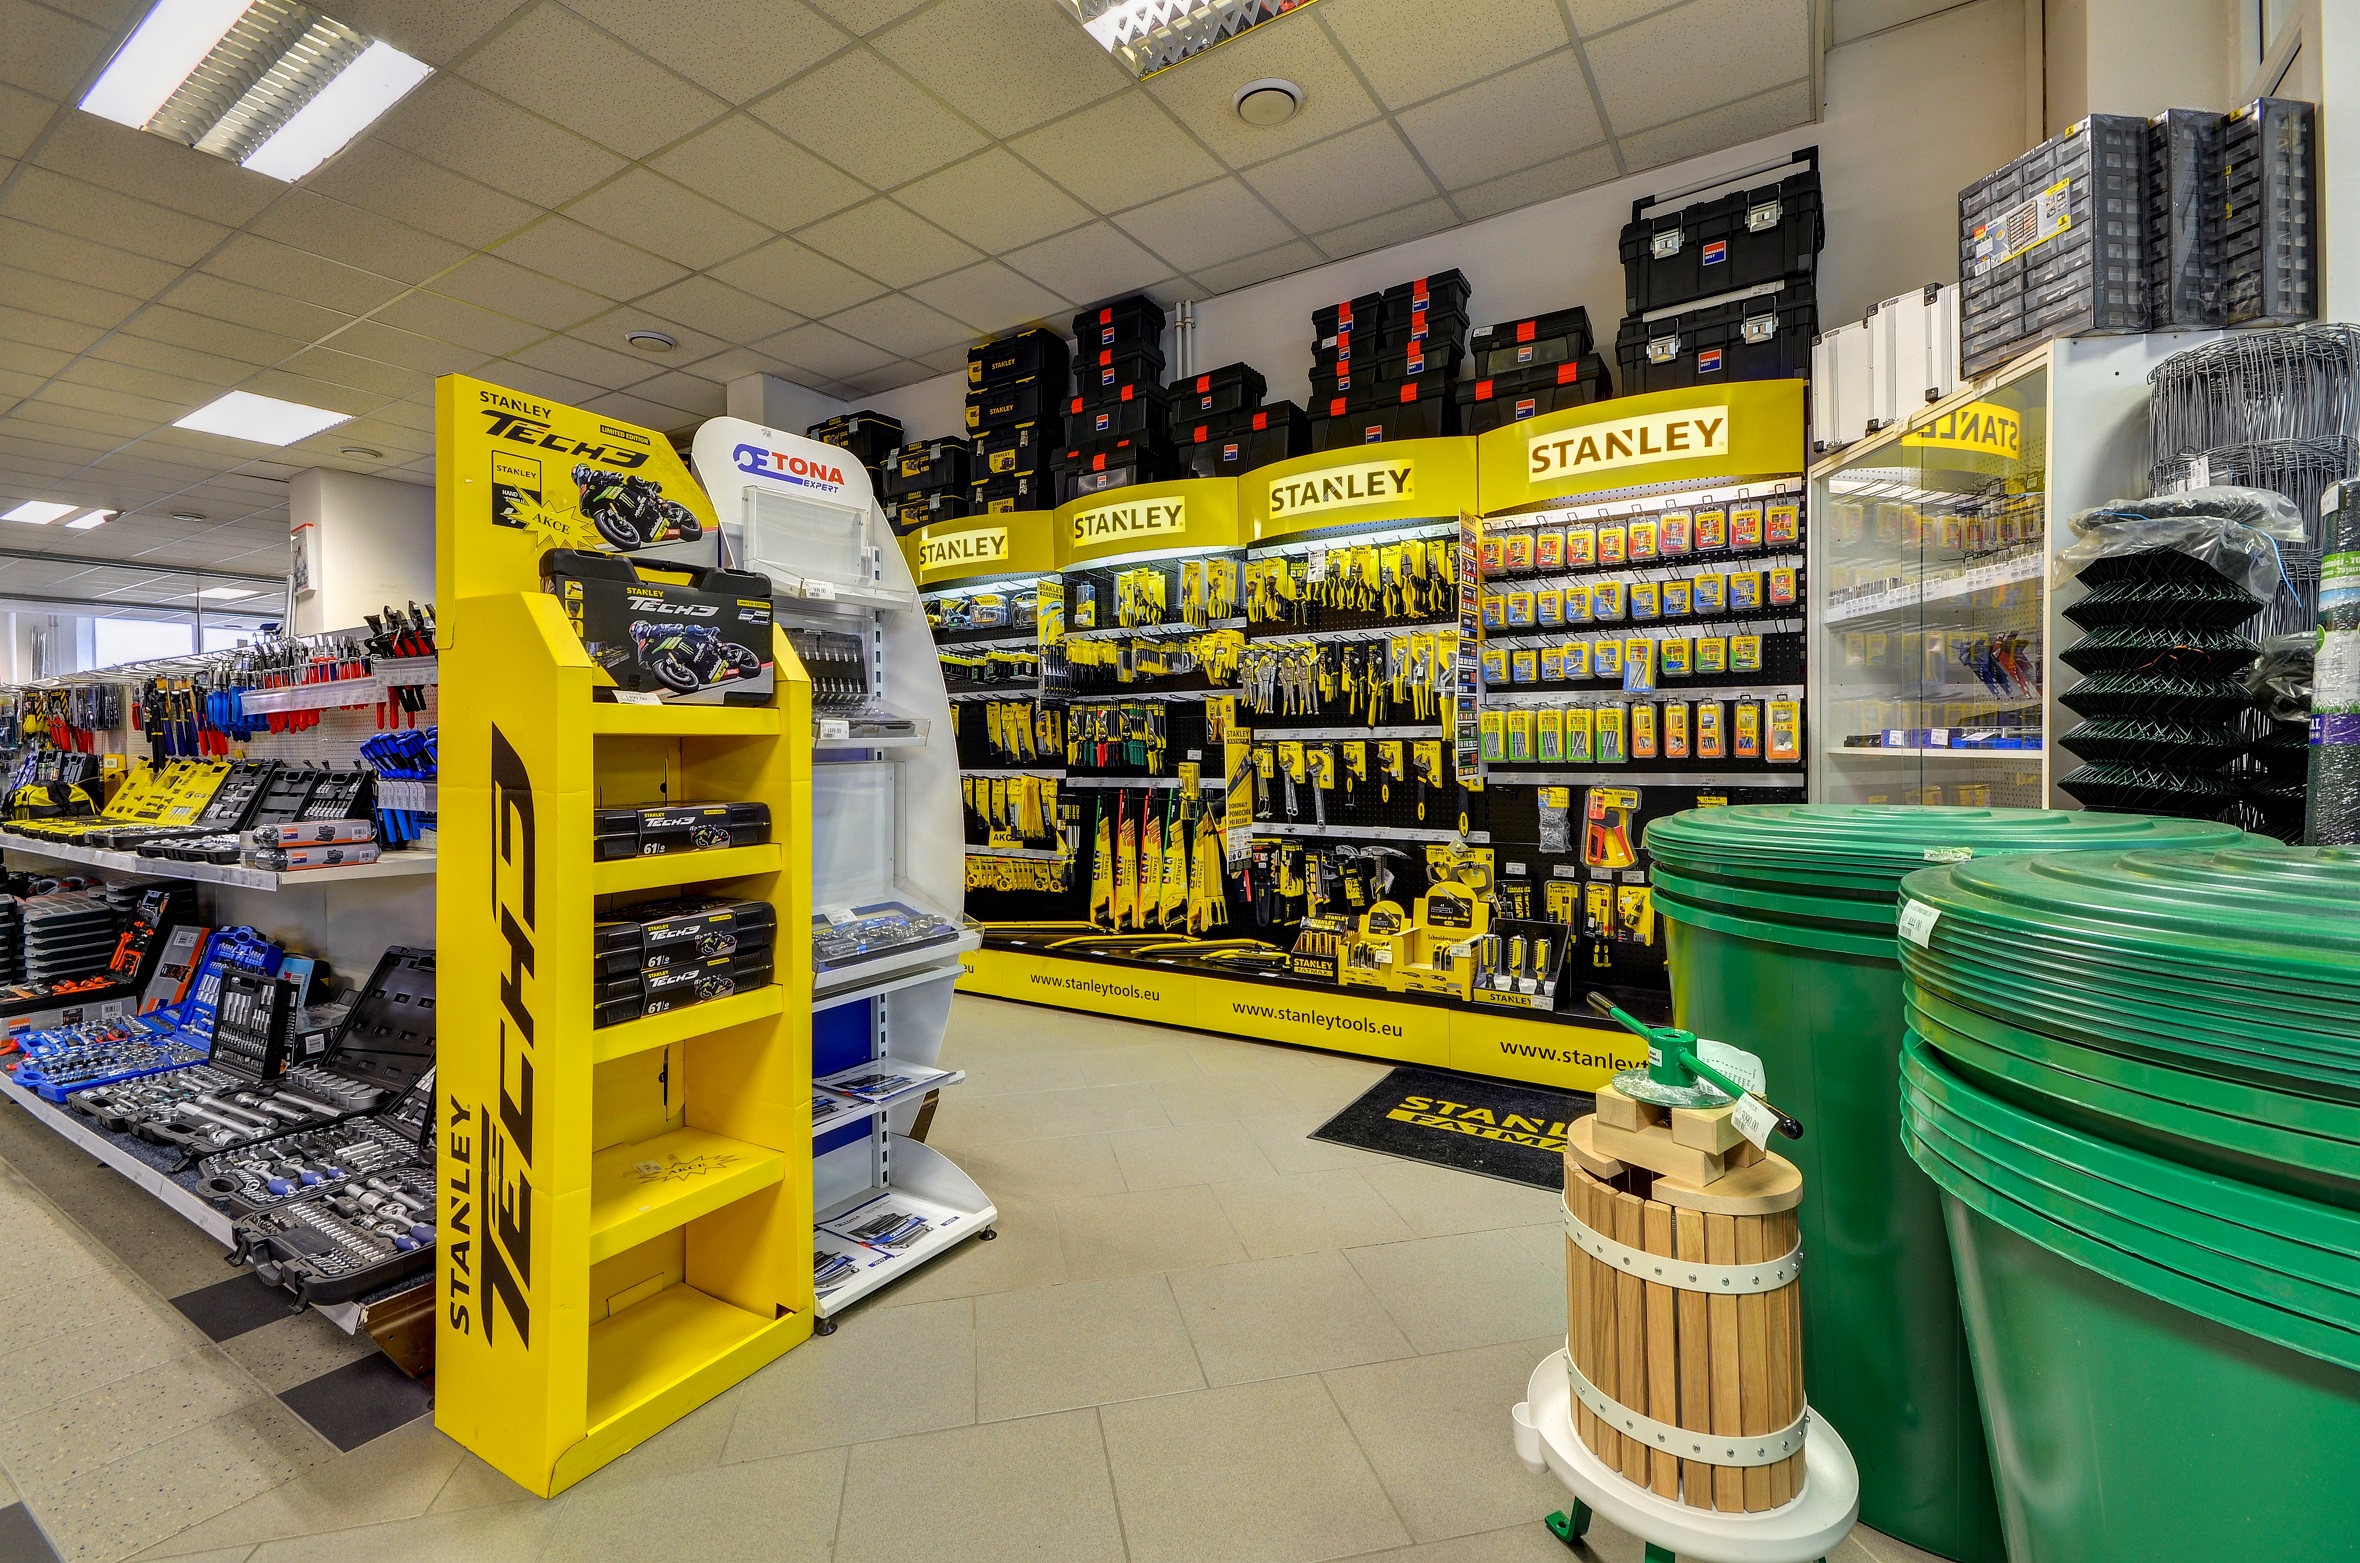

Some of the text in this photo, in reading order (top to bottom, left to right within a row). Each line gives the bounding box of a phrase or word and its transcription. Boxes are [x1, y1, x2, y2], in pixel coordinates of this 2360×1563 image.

[991, 358, 1015, 370] STANLEY
[480, 391, 551, 419] STANLEY
[990, 404, 1014, 416] STANLEY
[602, 427, 648, 445] LIMITED EDITION
[1532, 417, 1724, 474] STANLEY
[496, 464, 537, 479] STANLEY
[771, 451, 845, 485] TONA
[804, 479, 839, 494] EXPERT
[1271, 467, 1411, 512] STANLEY
[532, 513, 570, 535] AKCE
[1074, 505, 1182, 539] STANLEY
[920, 535, 1006, 565] STANLEY
[627, 587, 664, 597] STANLEY
[1039, 584, 1063, 593] STANLEY
[993, 833, 1012, 842] AKC
[648, 924, 669, 932] STANLEY
[1294, 958, 1333, 970] STANLEY
[1297, 967, 1328, 975] FATMAX
[648, 970, 669, 979] STANLEY
[1030, 973, 1160, 1001] www.stanleytools.eu
[1490, 993, 1531, 1005] STANLEY
[1232, 1002, 1402, 1037] www.stanleytools.eu
[1399, 1096, 1568, 1137] STANL
[450, 1093, 470, 1336] STANLEY
